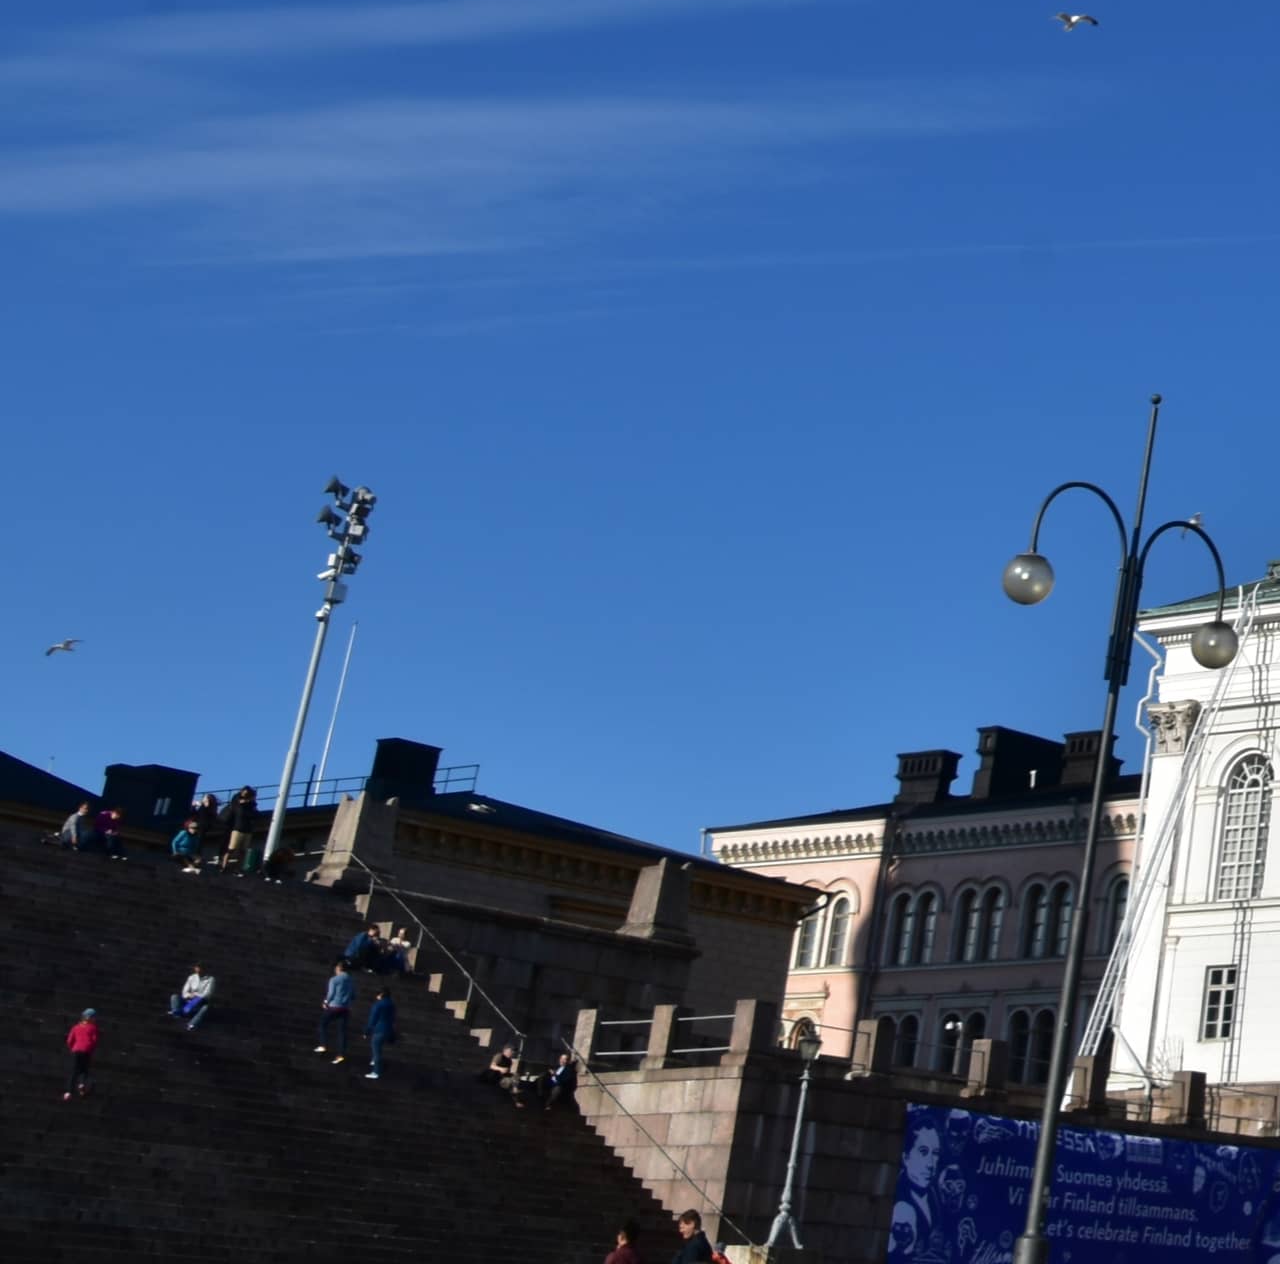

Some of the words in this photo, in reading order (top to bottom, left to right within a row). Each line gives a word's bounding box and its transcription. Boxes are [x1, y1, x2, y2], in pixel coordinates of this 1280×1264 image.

[975, 1153, 1036, 1179] Juhlim
[1056, 1163, 1113, 1187] Suomea
[1116, 1169, 1172, 1194] yhdessä.
[1007, 1184, 1025, 1207] Vi
[1062, 1191, 1115, 1215] Finland
[1118, 1196, 1199, 1222] tillsammans.
[1077, 1220, 1139, 1243] celebrate
[1141, 1225, 1192, 1248] Finland
